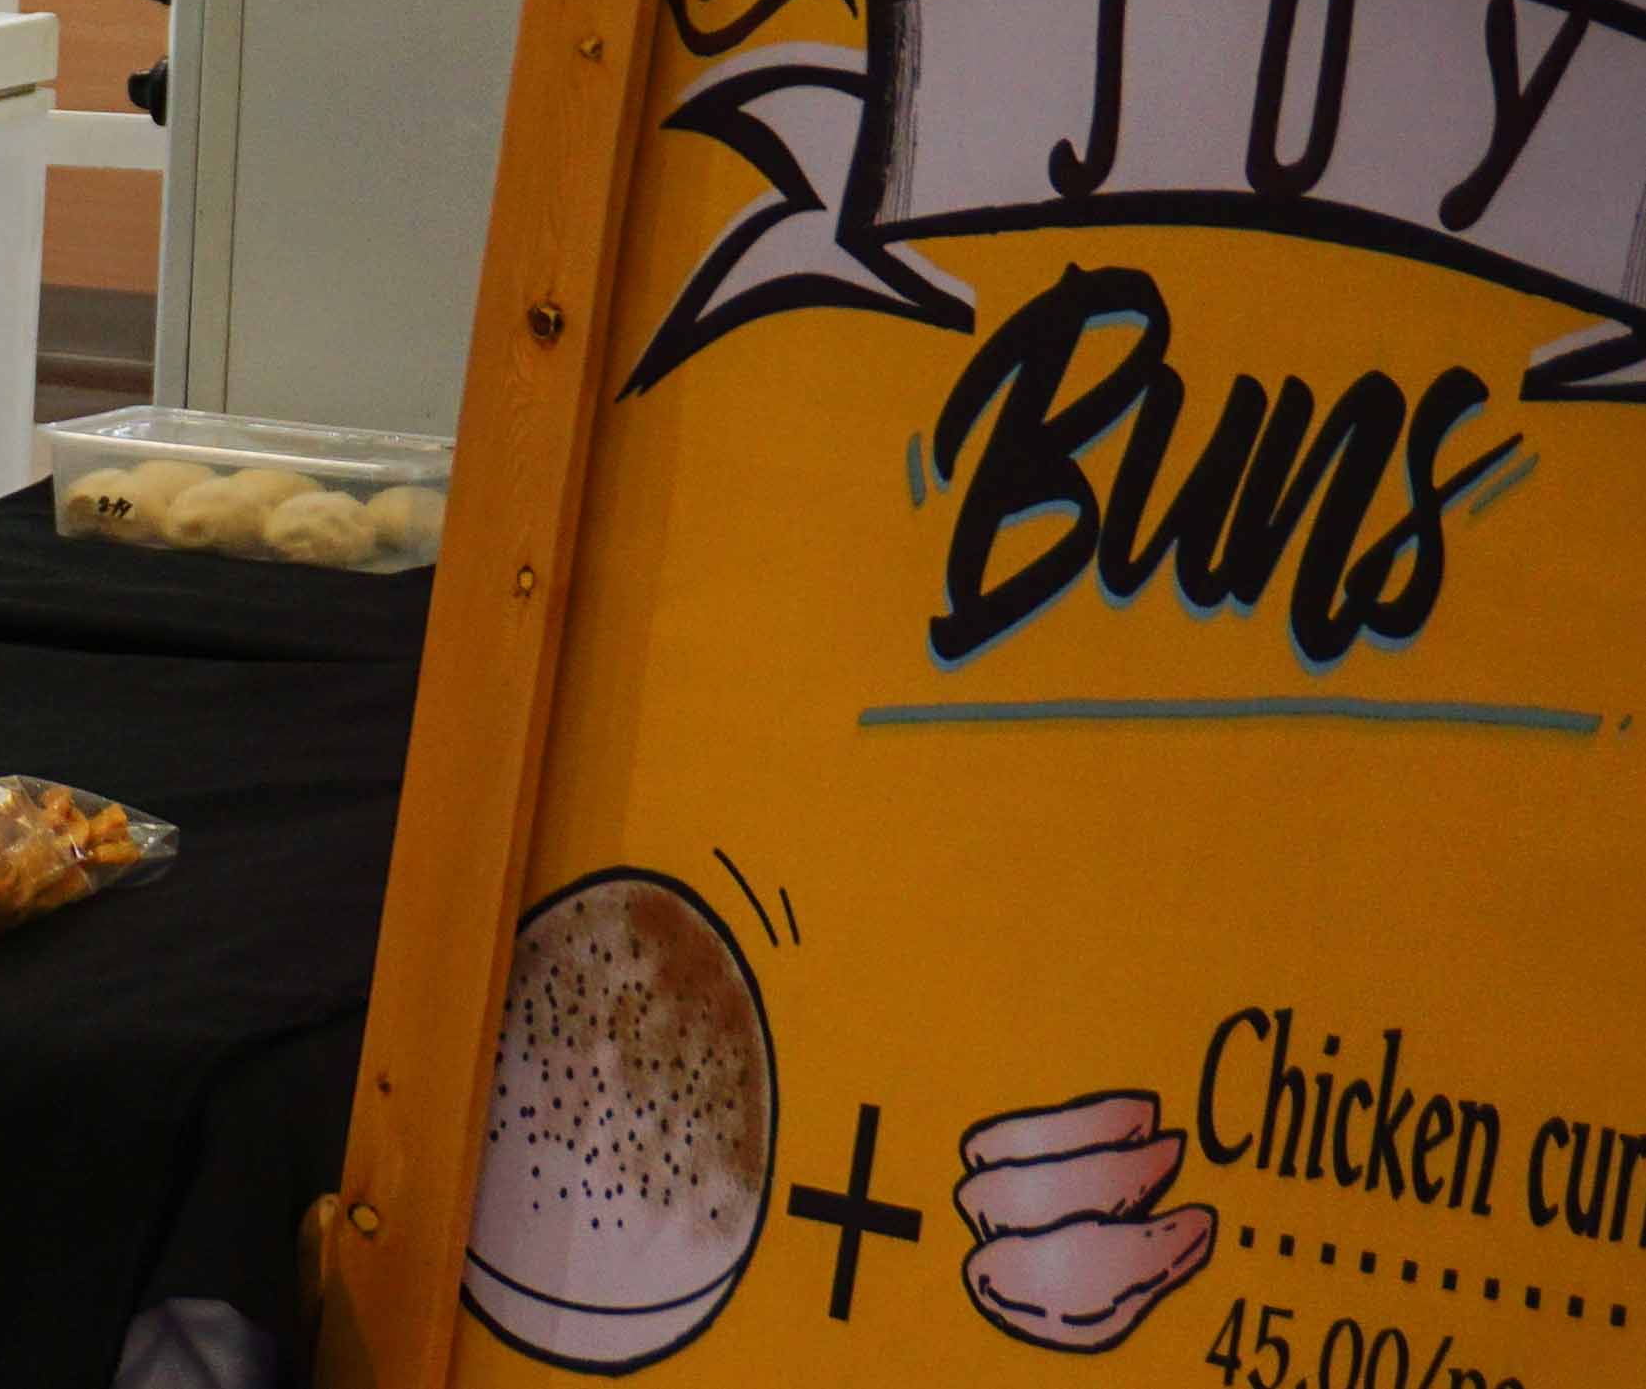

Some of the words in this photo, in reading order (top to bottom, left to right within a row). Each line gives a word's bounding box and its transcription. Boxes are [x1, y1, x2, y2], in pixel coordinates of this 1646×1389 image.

[931, 262, 1523, 668] Buns
[1196, 1006, 1502, 1217] Chicken
[1527, 1115, 1646, 1249] cur
[1205, 1296, 1525, 1389] 45.00/
